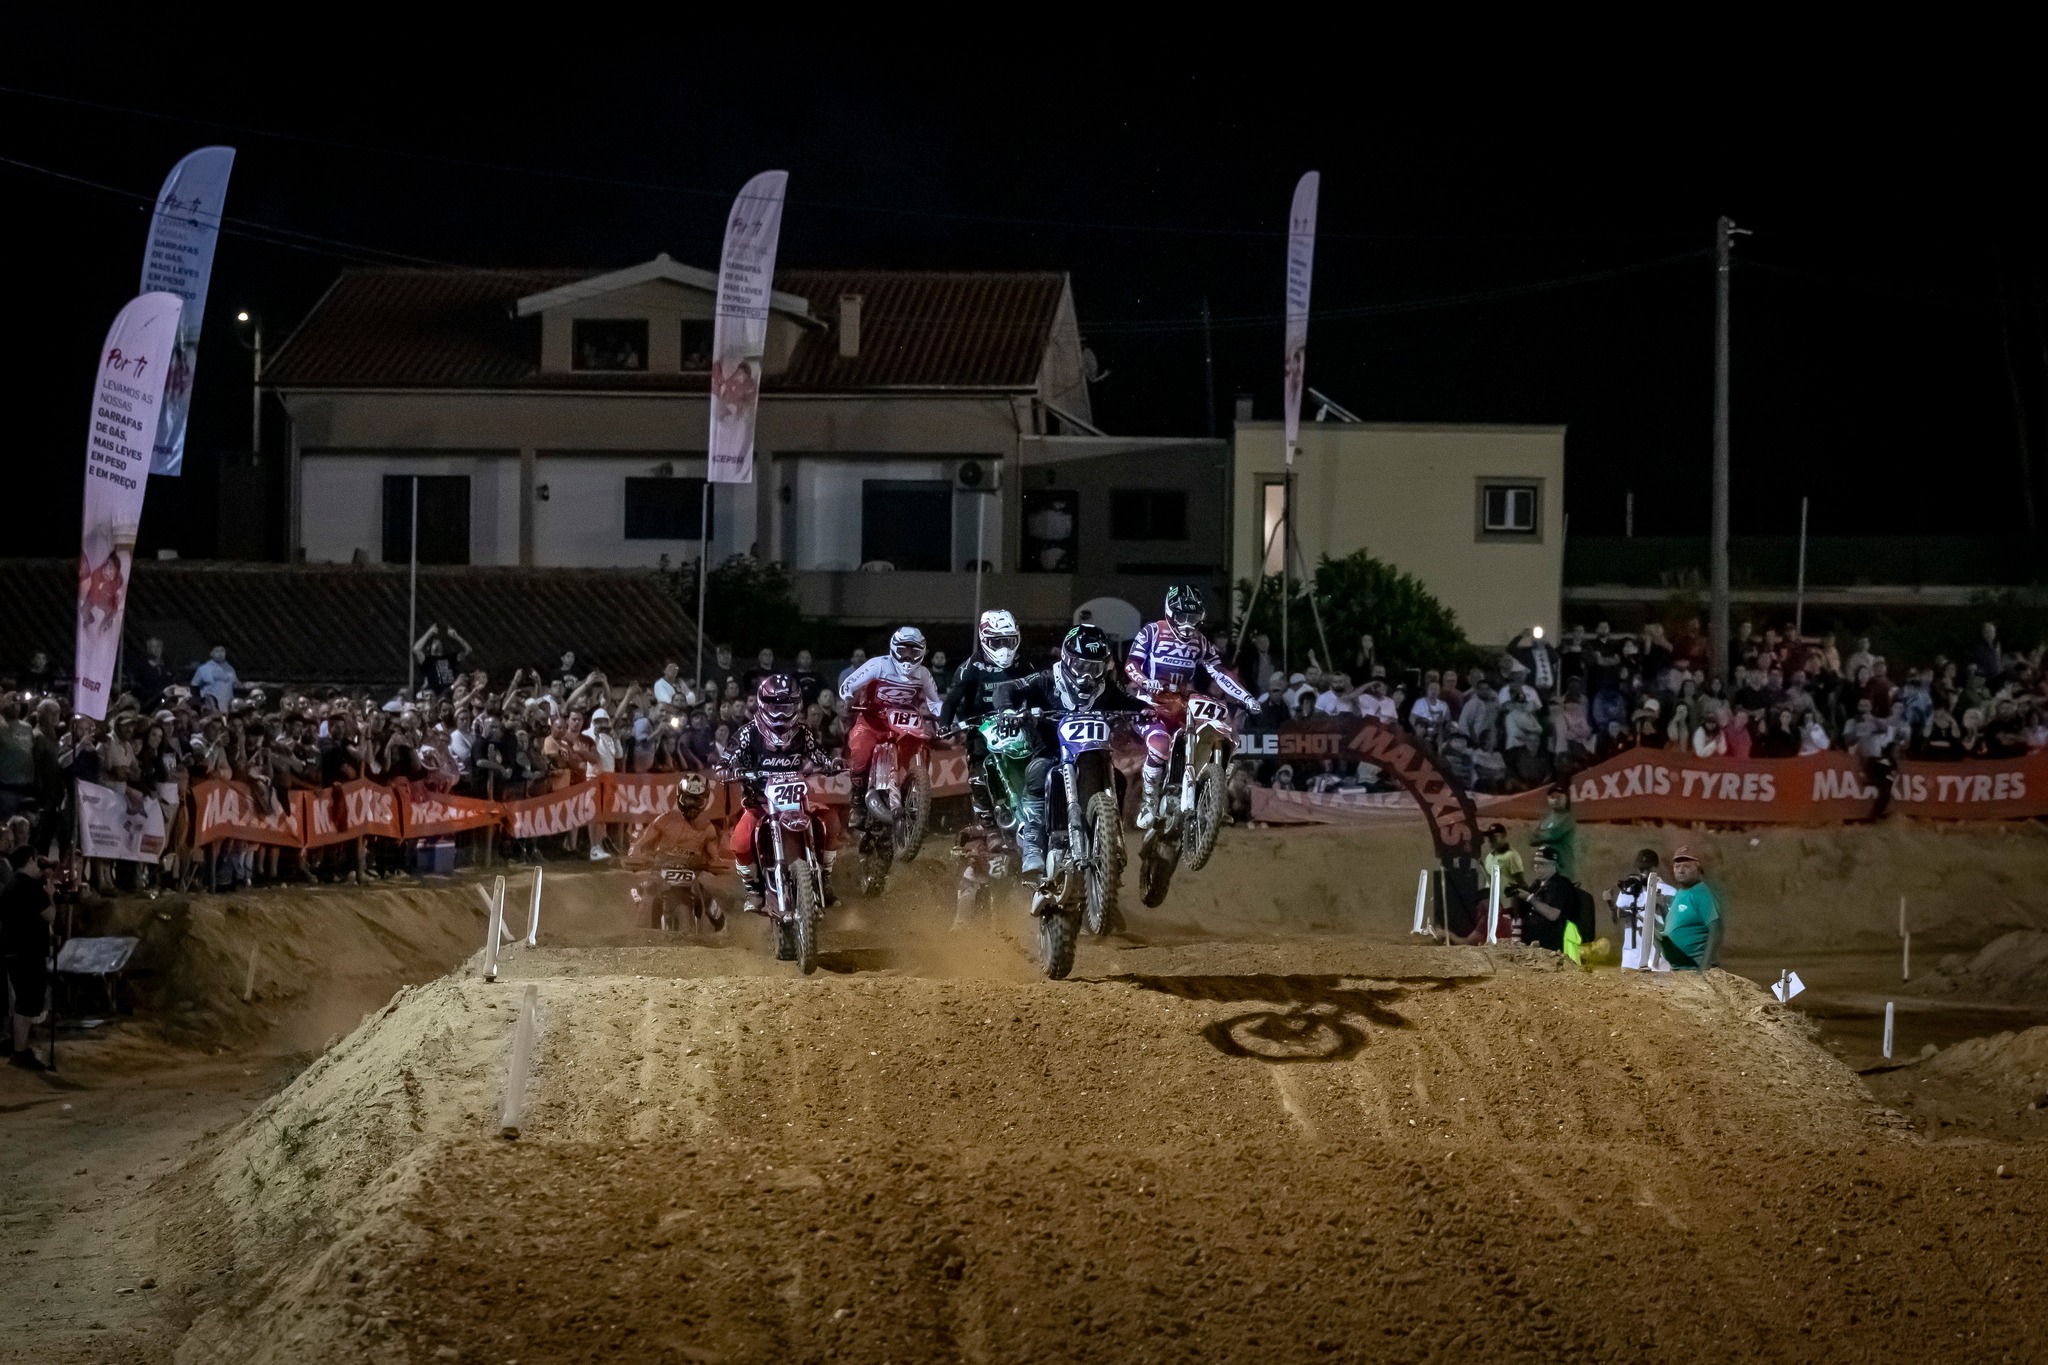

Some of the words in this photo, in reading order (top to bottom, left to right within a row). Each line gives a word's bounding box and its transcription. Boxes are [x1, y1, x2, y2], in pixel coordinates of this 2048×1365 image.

[152, 250, 163, 260] DE
[154, 239, 199, 256] GARRAFAS
[150, 262, 171, 273] MAIS
[172, 265, 200, 279] LEVES
[106, 347, 131, 371] Por
[102, 378, 140, 401] LEVAMOS
[141, 392, 154, 405] AS
[100, 393, 133, 412] NOSSAS
[96, 421, 108, 434] DE
[98, 407, 143, 431] GARRAFAS
[93, 436, 115, 452] MAIS
[116, 445, 143, 462] LEVES
[91, 450, 104, 464] EM
[105, 455, 127, 471] PESO
[96, 466, 109, 479] EM
[109, 471, 137, 490] PREÇO
[1162, 657, 1192, 666] MOTO
[1219, 675, 1242, 696] MOTO
[893, 712, 921, 726] 187
[1069, 722, 1105, 740] 211
[774, 784, 806, 805] 248
[1350, 725, 1472, 846] MAXXIS
[1681, 769, 1776, 802] TYRES
[1936, 772, 2026, 803] TYRES
[313, 787, 393, 834] MXXIS
[514, 786, 597, 838] MAXXIS
